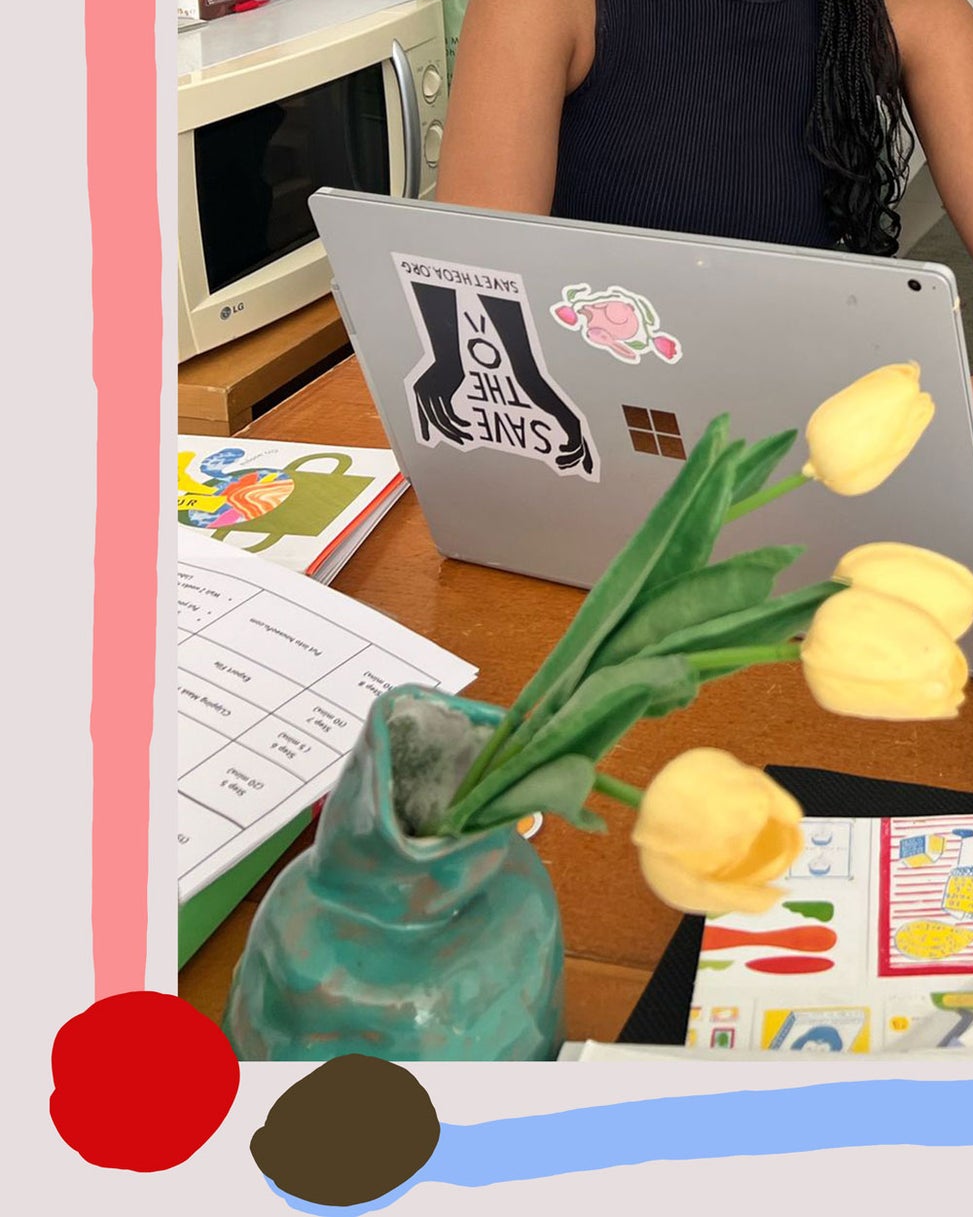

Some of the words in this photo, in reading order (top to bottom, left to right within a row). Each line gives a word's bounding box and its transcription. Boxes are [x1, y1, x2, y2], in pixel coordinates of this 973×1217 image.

[401, 261, 519, 294] SAVETHEOA.ORG
[232, 302, 245, 314] LG
[467, 371, 533, 409] THE
[472, 406, 552, 454] SAVE
